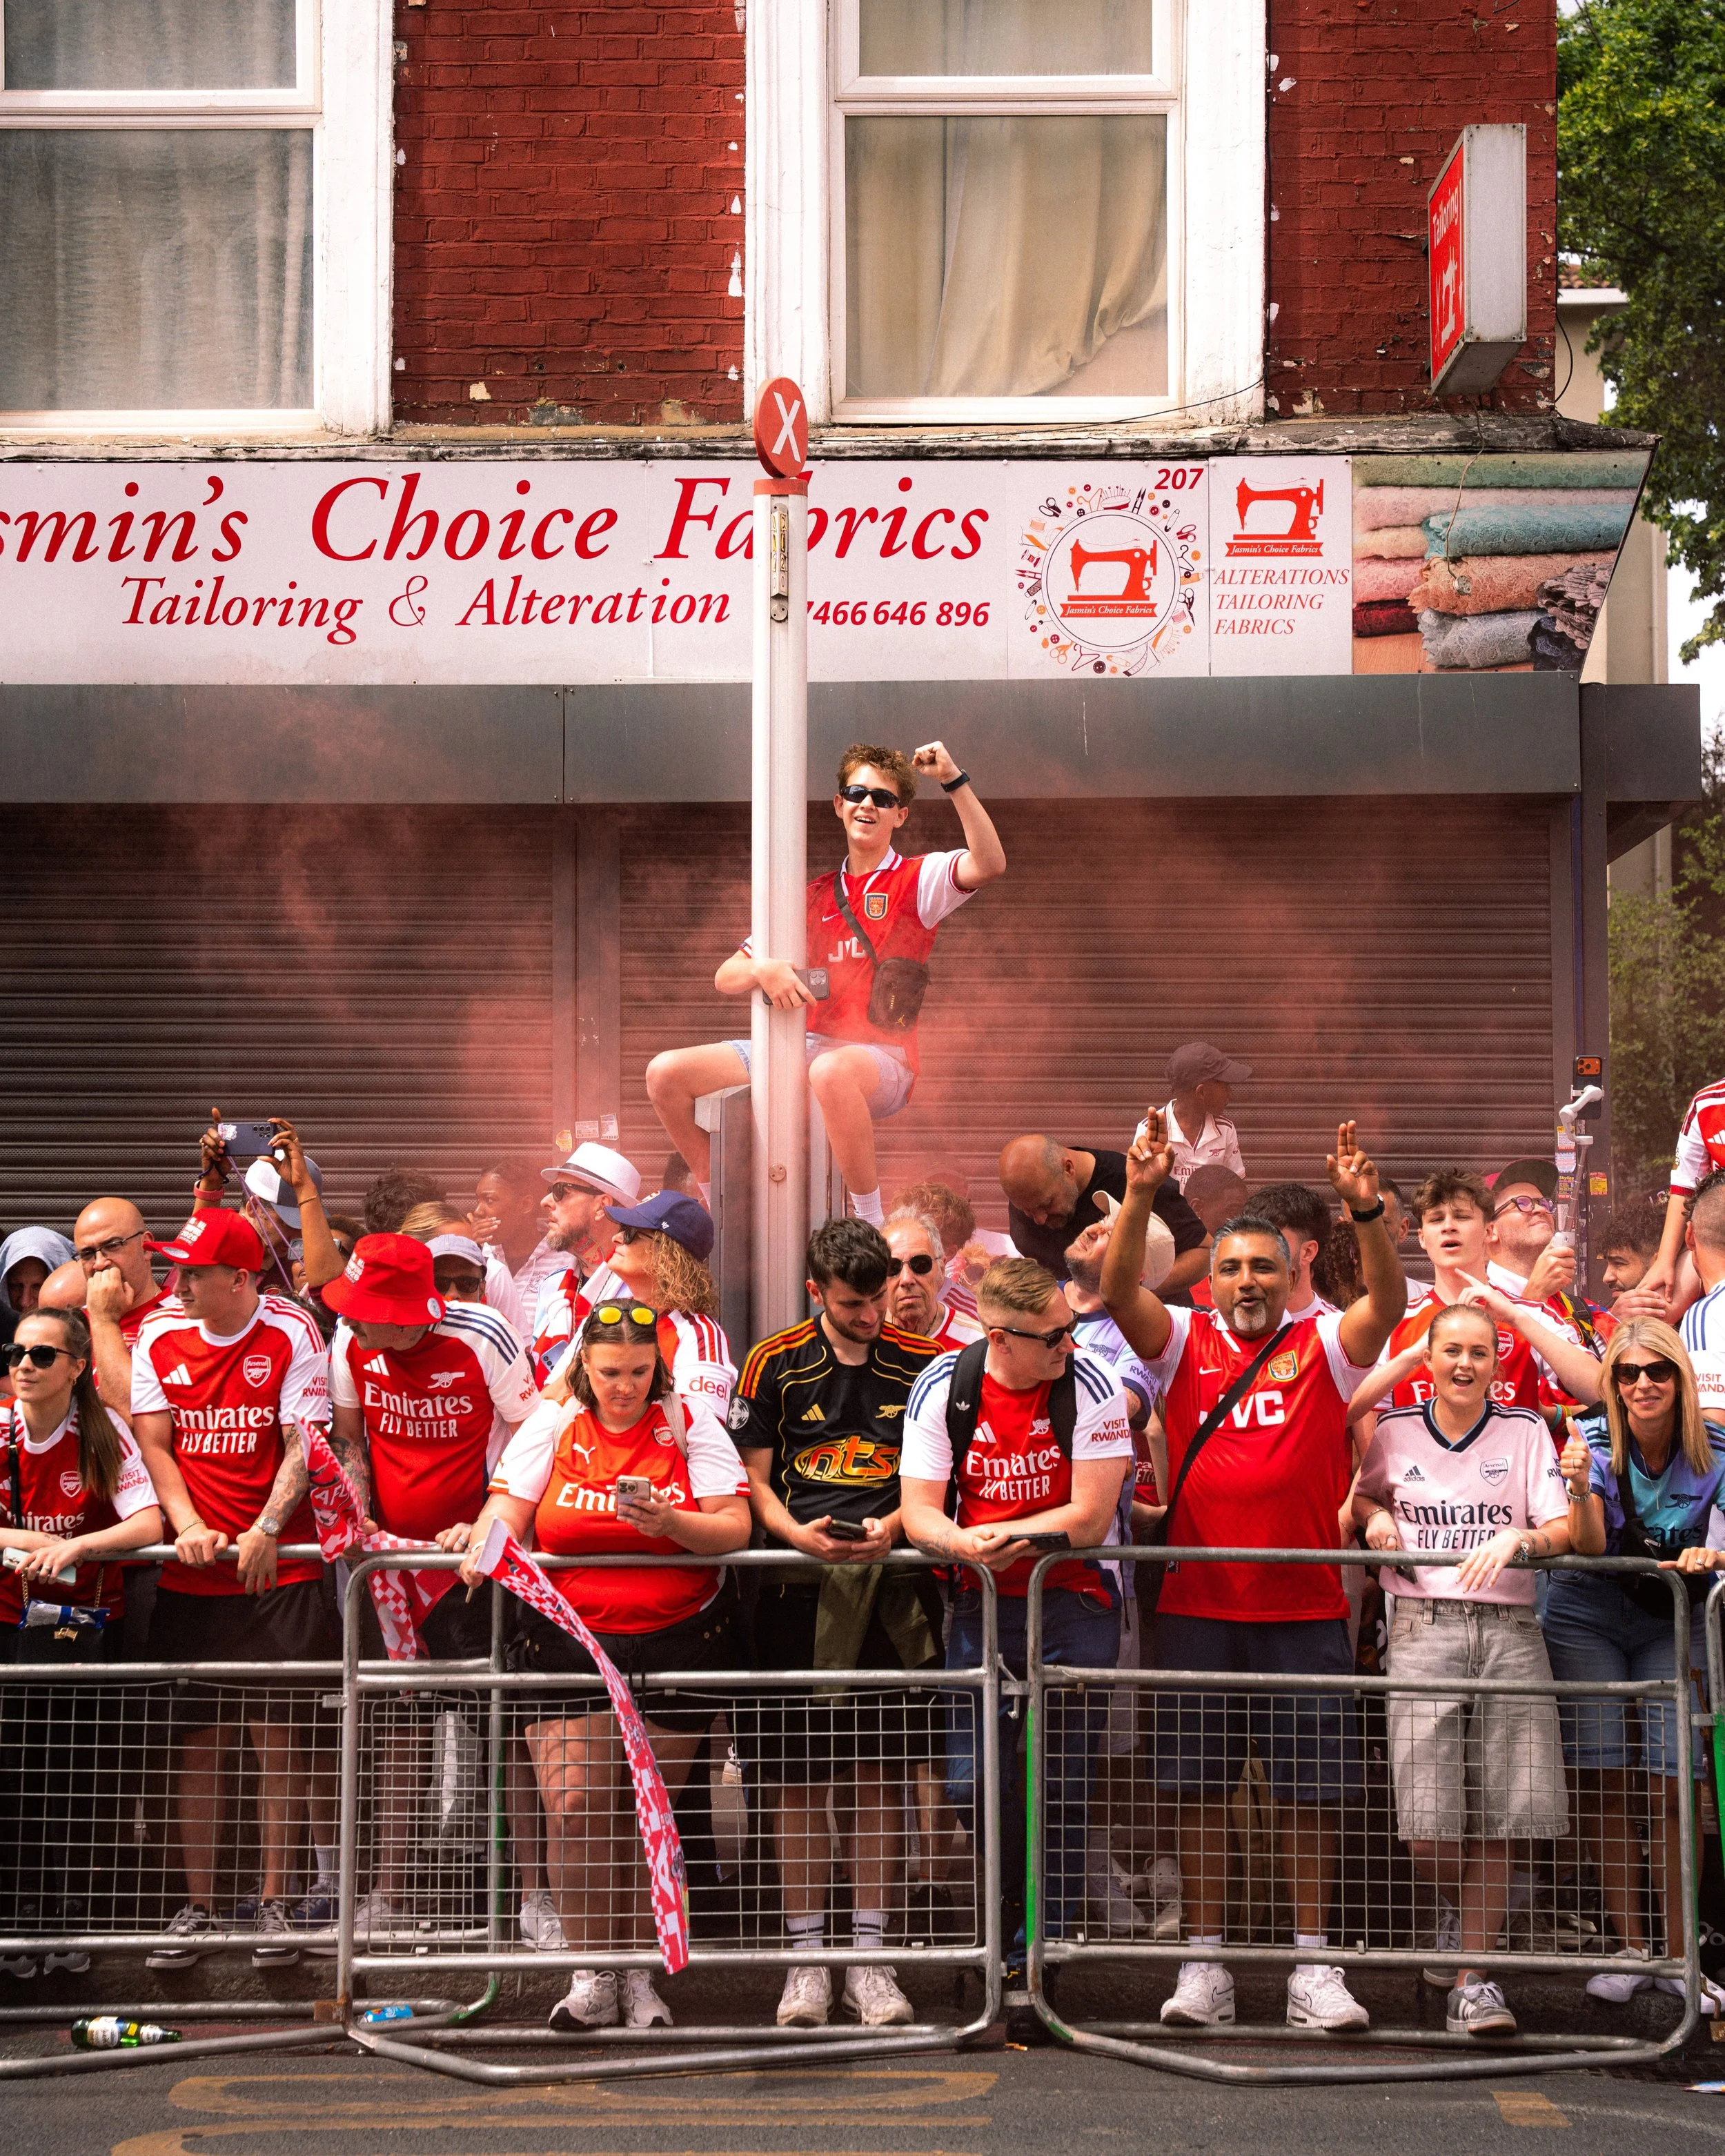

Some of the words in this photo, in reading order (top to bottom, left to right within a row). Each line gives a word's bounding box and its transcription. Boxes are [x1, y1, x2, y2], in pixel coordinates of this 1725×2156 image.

[1432, 186, 1459, 250] Tailoring
[1154, 468, 1204, 490] 207
[312, 473, 618, 562] Choice
[1231, 545, 1261, 554] Jasmin's
[1263, 545, 1289, 553] Choice
[1292, 545, 1318, 553] Fabrics
[1213, 569, 1350, 584] ALTERATIONS
[121, 575, 364, 646] Tailoring
[388, 575, 428, 626] &
[455, 574, 730, 626] Alteration
[1065, 606, 1096, 615] Jasmin's
[1098, 605, 1123, 614] Choice
[1125, 606, 1152, 614] Fabrics
[1216, 594, 1324, 609] TAILORING
[873, 601, 927, 626] 646
[935, 601, 990, 627] 896
[1214, 619, 1295, 634] FABRICS
[827, 936, 866, 962] JVC
[1694, 1373, 1722, 1382] VISIT
[1697, 1383, 1725, 1394] AND
[364, 1381, 473, 1418] Emirates
[168, 1403, 275, 1430] Emirates
[379, 1412, 402, 1434] FLY
[406, 1418, 458, 1438] BETTER
[1103, 1418, 1125, 1431] VISIT
[181, 1432, 203, 1453] FLY
[202, 1432, 257, 1454] BETTER
[966, 1445, 1061, 1478] Emiates
[1000, 1475, 1050, 1501] BETTER
[1403, 1473, 1426, 1482] adidas
[555, 1482, 686, 1512] Emies
[1400, 1499, 1512, 1525] Emirates
[1418, 1529, 1439, 1550] FLY
